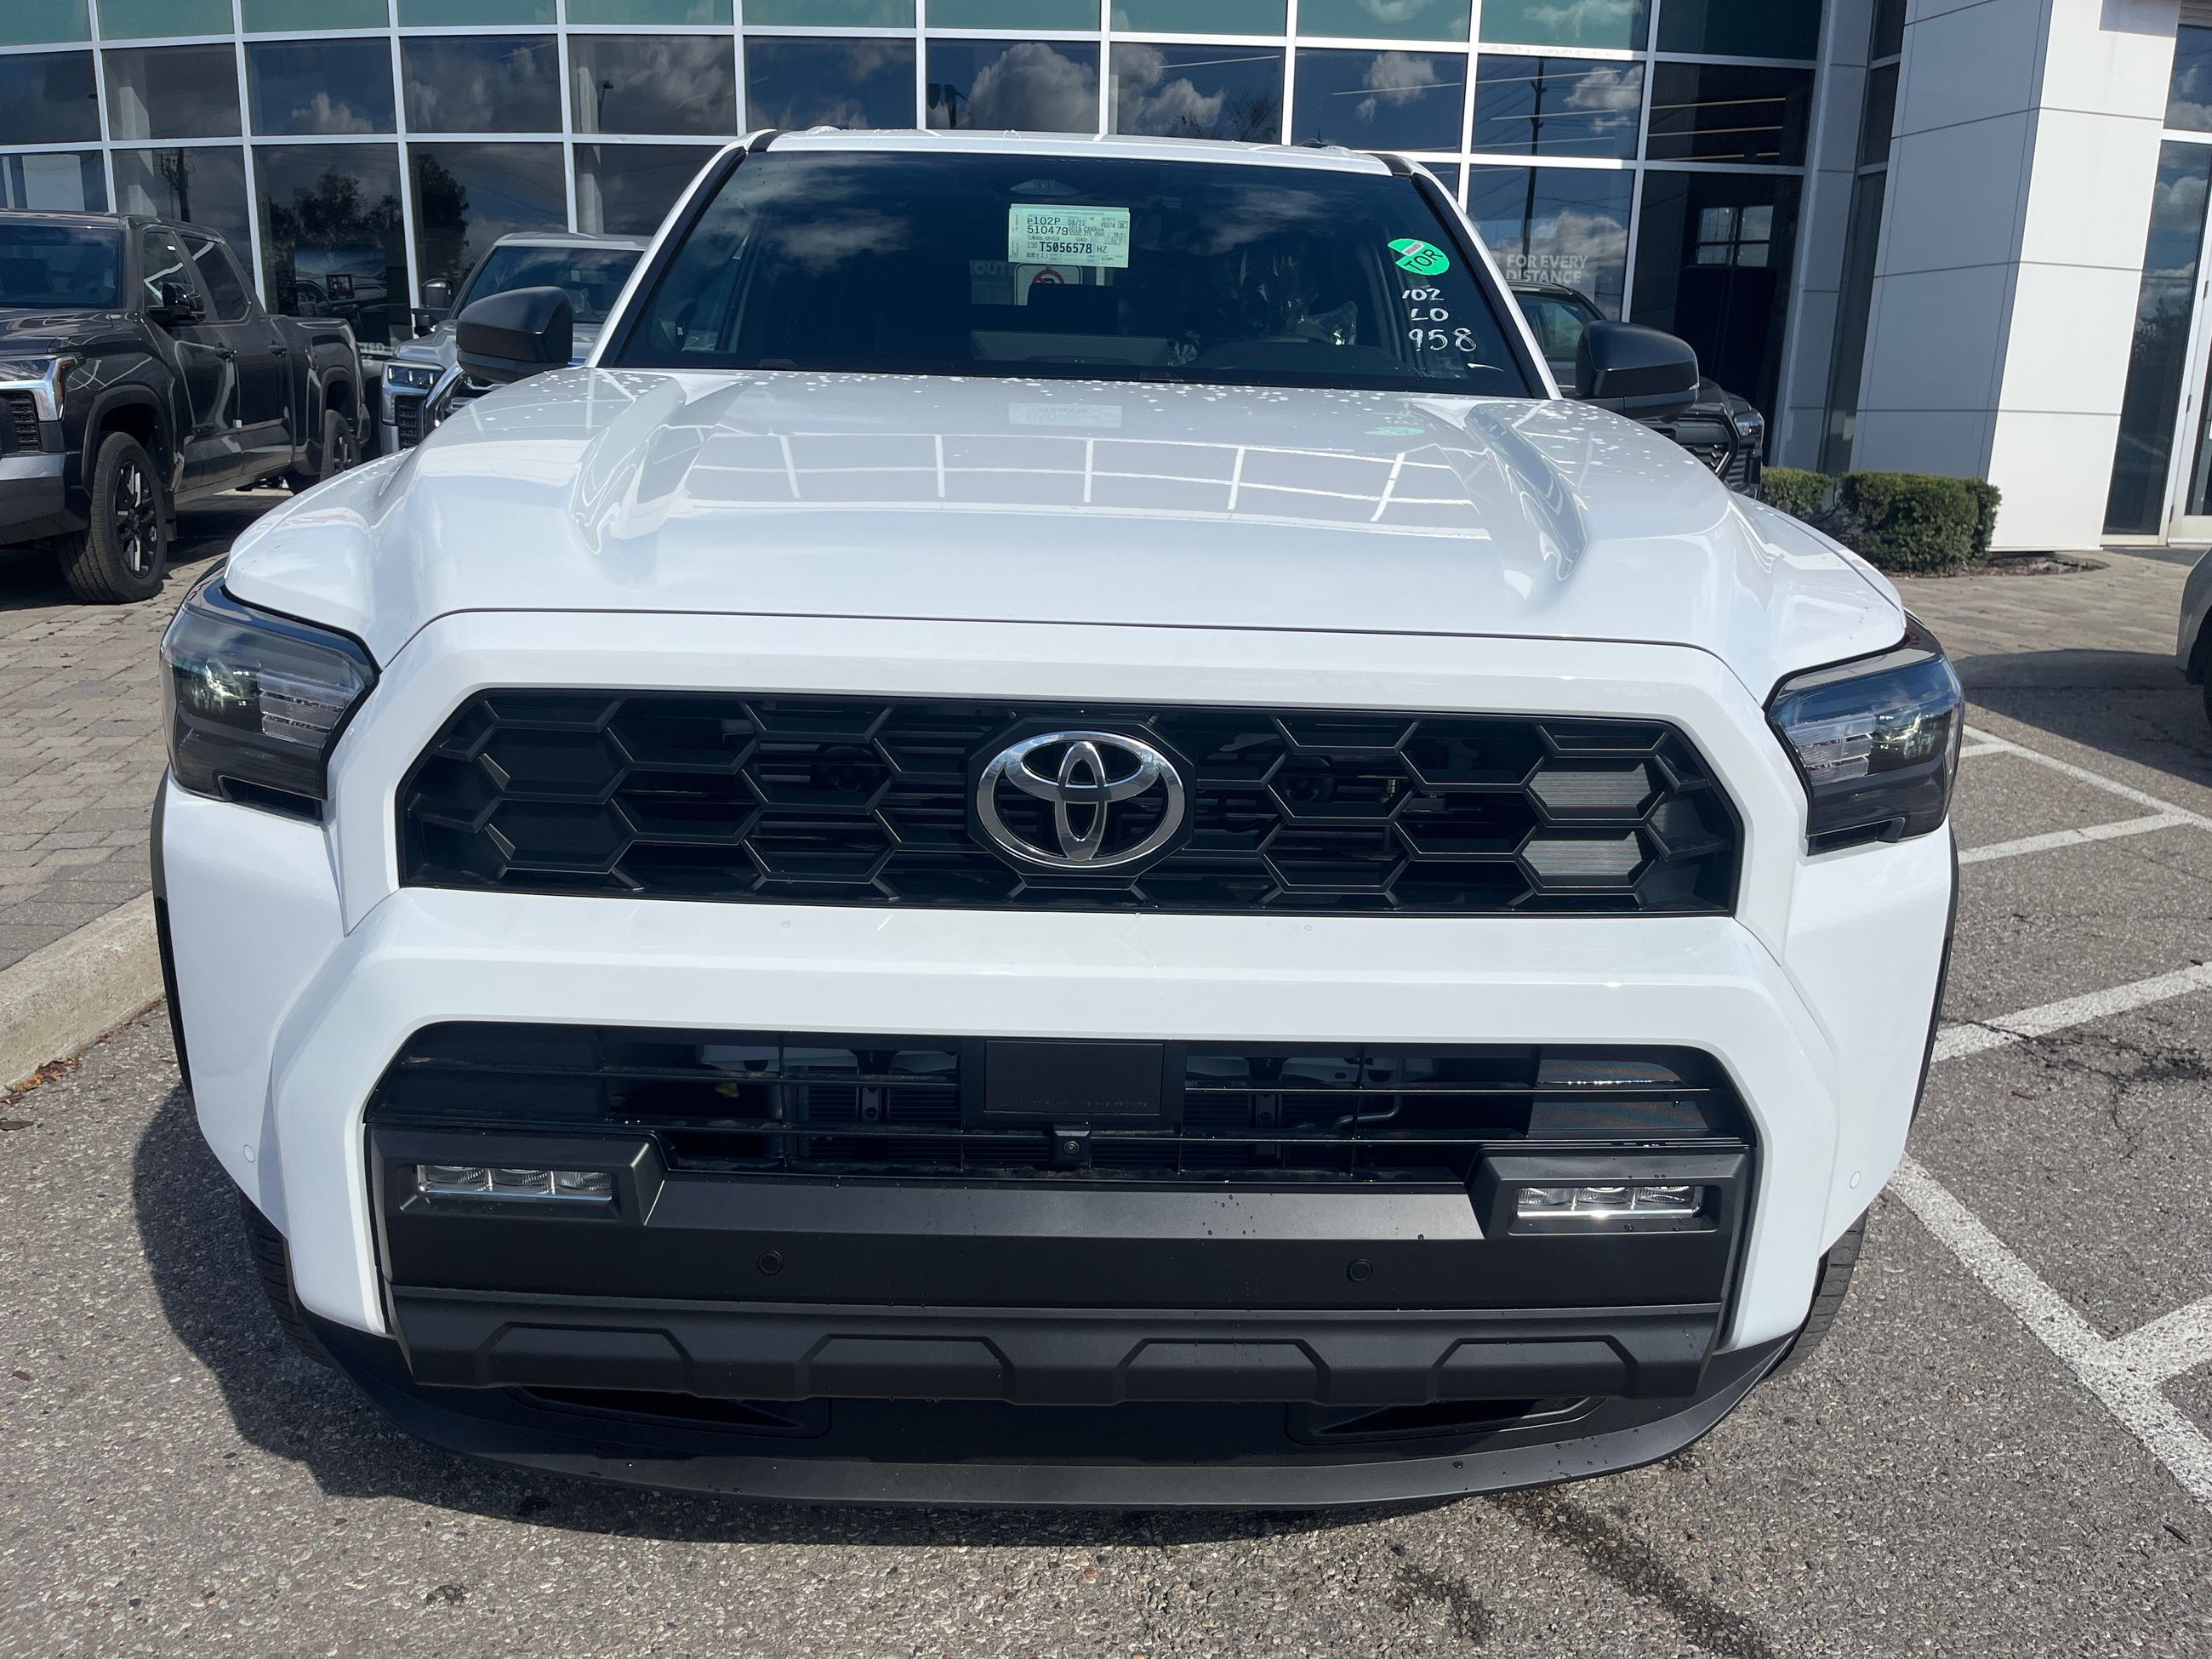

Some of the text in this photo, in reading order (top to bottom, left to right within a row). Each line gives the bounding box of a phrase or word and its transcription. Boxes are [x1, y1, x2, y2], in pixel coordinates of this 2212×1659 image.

[1027, 225, 1069, 236] 510479
[1039, 242, 1092, 254] T5056578
[1097, 245, 1108, 254] HZ
[1404, 249, 1444, 271] TOR
[1506, 254, 1589, 270] FOR EVERY
[1505, 270, 1582, 284] DISTANCE
[1408, 328, 1477, 352] 958
